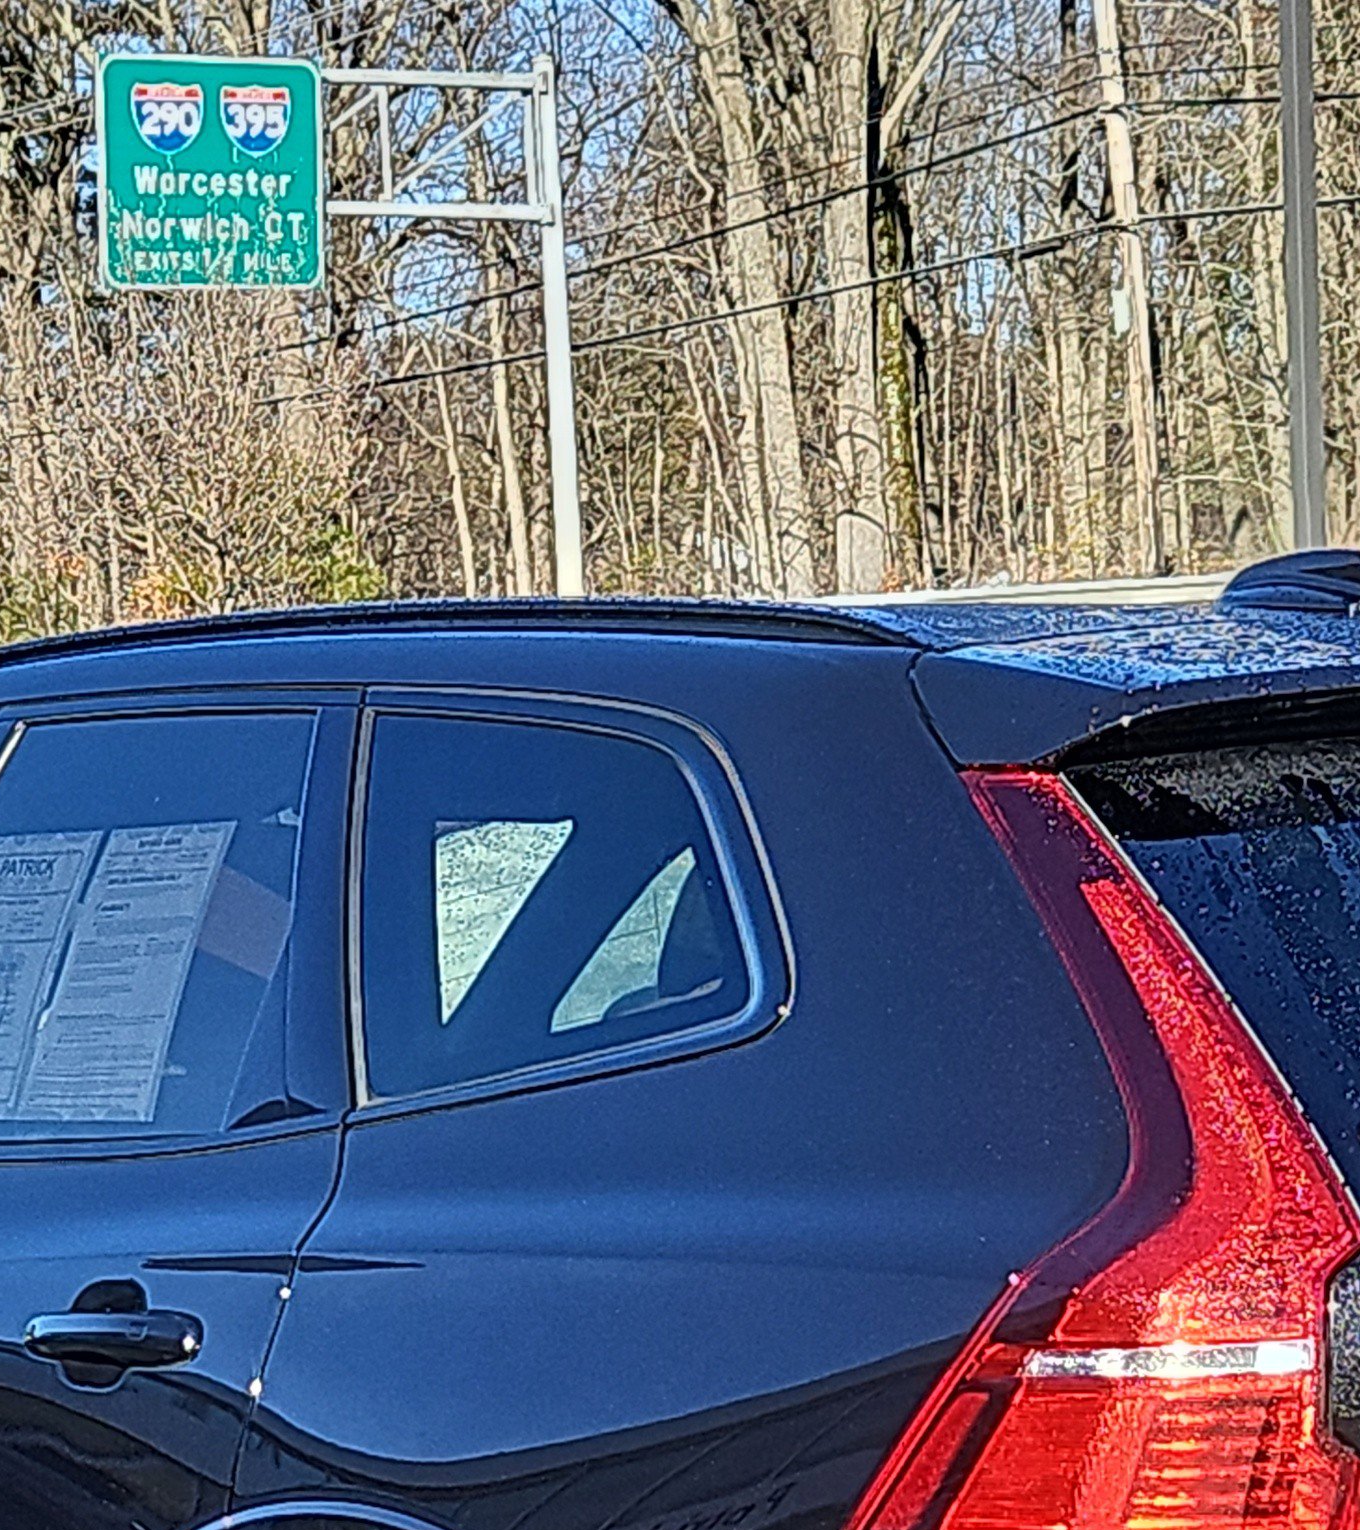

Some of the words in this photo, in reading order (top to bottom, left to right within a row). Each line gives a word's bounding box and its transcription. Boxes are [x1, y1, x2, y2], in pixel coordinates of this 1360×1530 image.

[141, 101, 199, 137] 290
[226, 103, 285, 138] 395
[133, 165, 292, 197] Worcester
[121, 208, 250, 241] Norwich
[264, 211, 305, 242] CT
